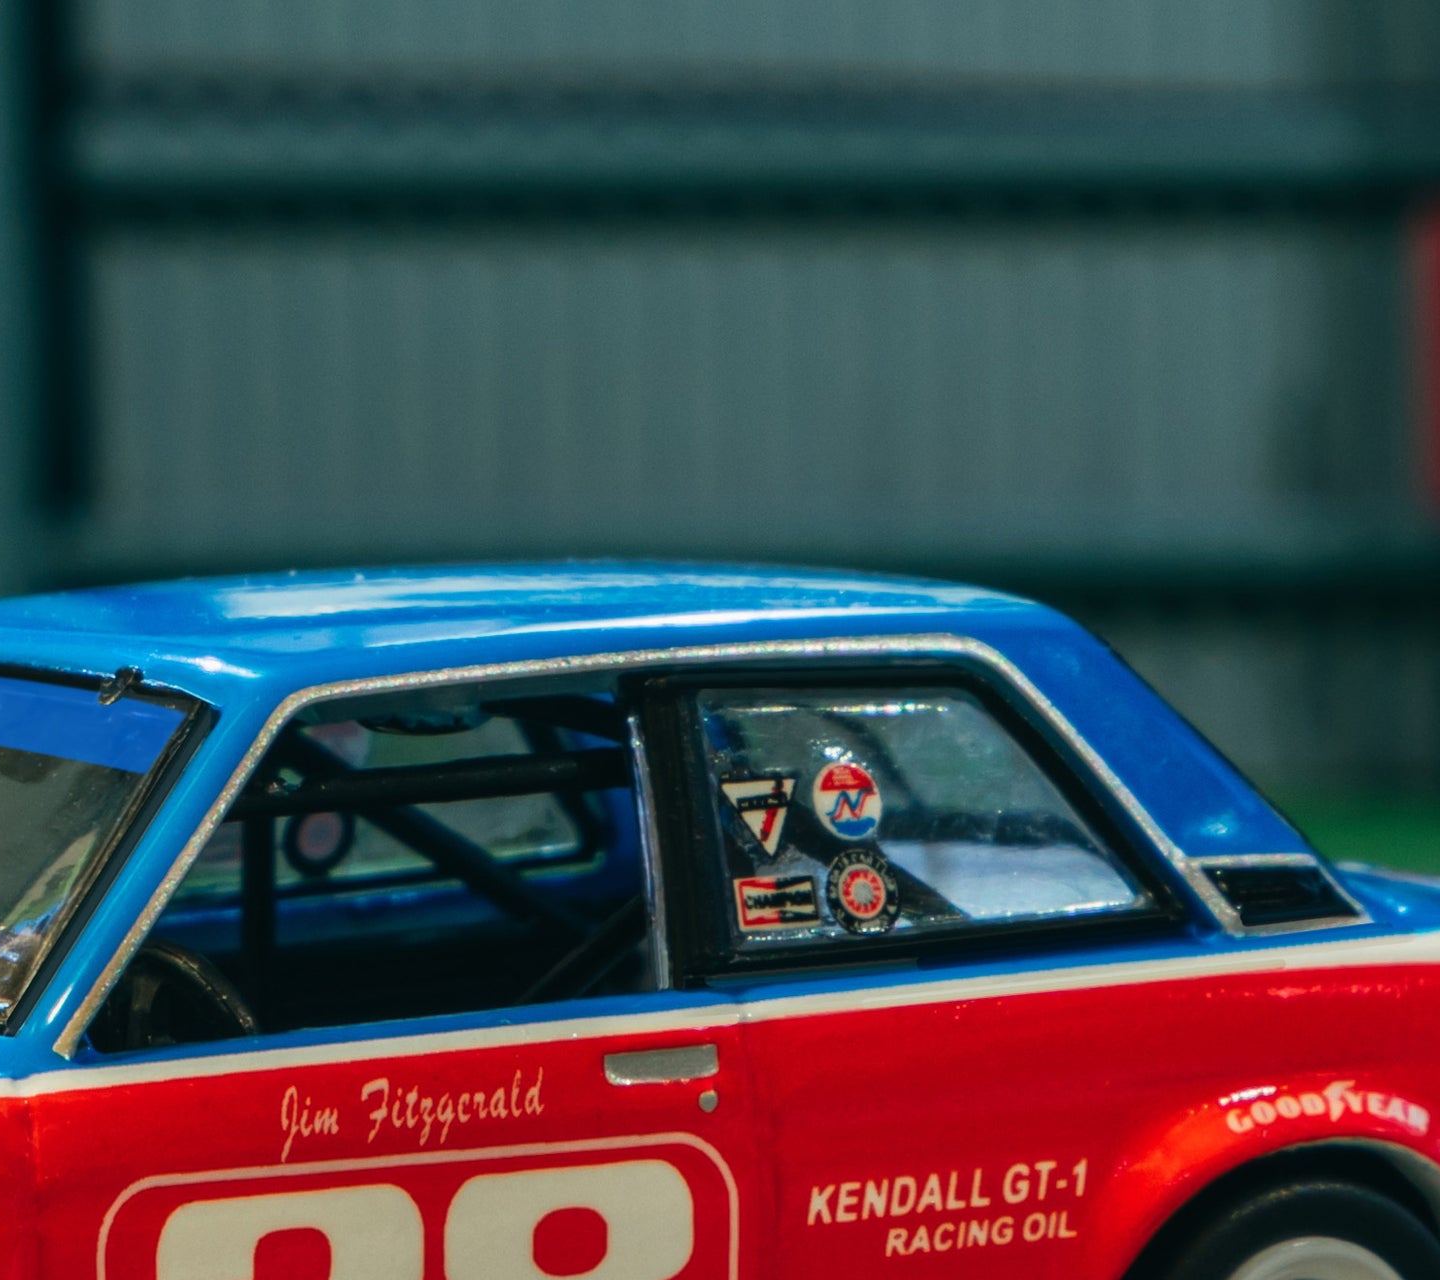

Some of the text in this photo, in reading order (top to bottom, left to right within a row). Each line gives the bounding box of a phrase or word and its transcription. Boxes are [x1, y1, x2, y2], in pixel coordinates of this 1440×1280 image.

[281, 1066, 545, 1163] Jim Fitzgerald
[1226, 1080, 1430, 1136] GOODYEAR
[807, 1157, 1088, 1226] KENDALL GT-1
[884, 1211, 1077, 1257] RACING OIL
